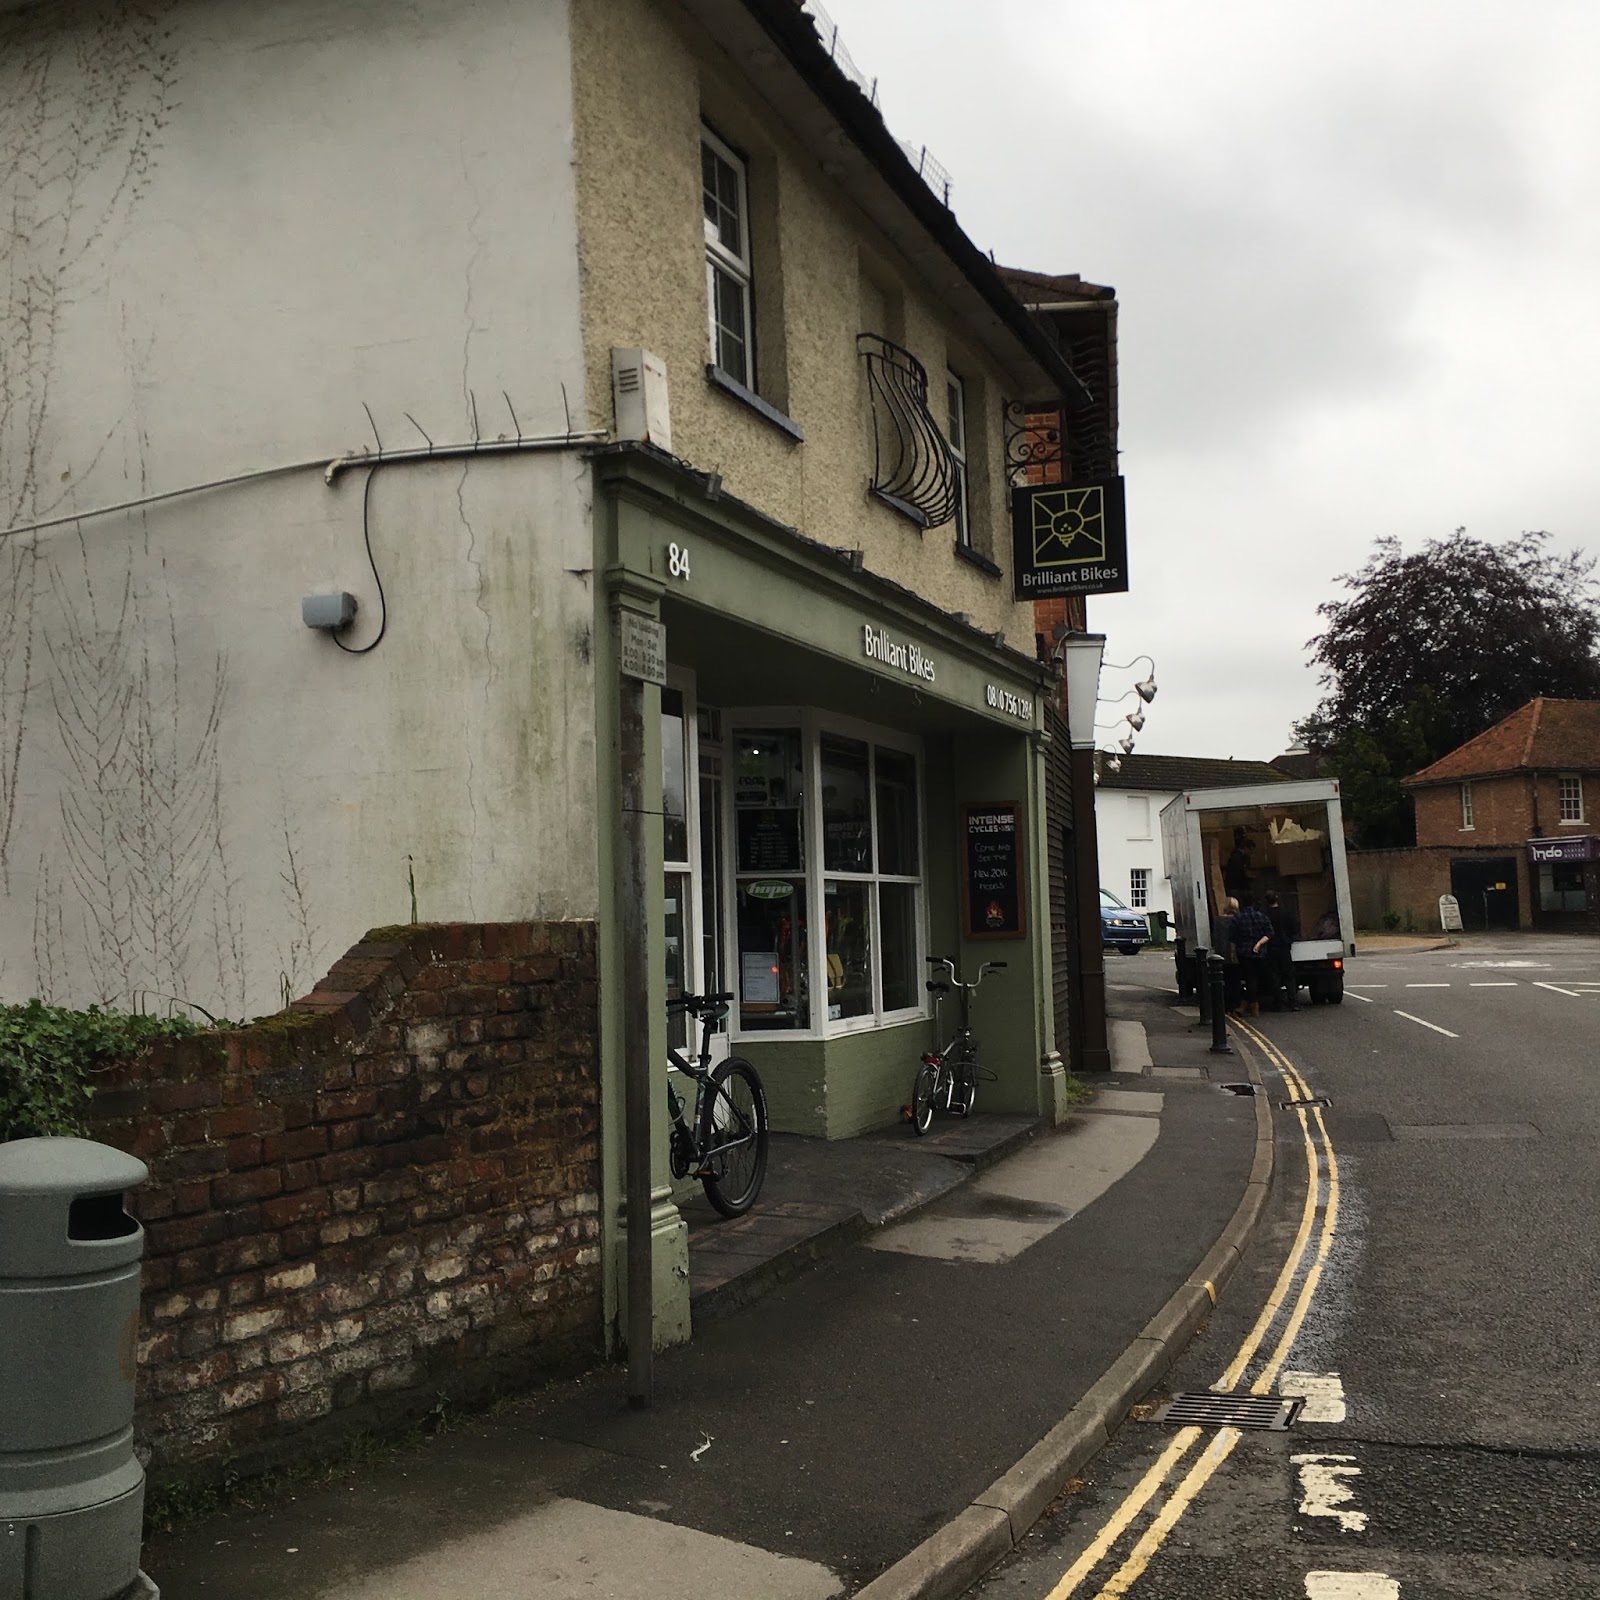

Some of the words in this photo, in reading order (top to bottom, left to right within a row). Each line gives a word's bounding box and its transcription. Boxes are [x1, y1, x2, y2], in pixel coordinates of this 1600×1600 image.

[668, 542, 690, 581] 84
[1022, 570, 1077, 587] Brilliant
[1080, 566, 1118, 582] Bikes
[865, 624, 908, 671] Brilliant
[909, 644, 936, 682] Bikes
[1004, 692, 1018, 716] 756
[968, 814, 1014, 825] INTENSE
[990, 868, 1008, 878] 2016
[748, 882, 793, 899] hope
